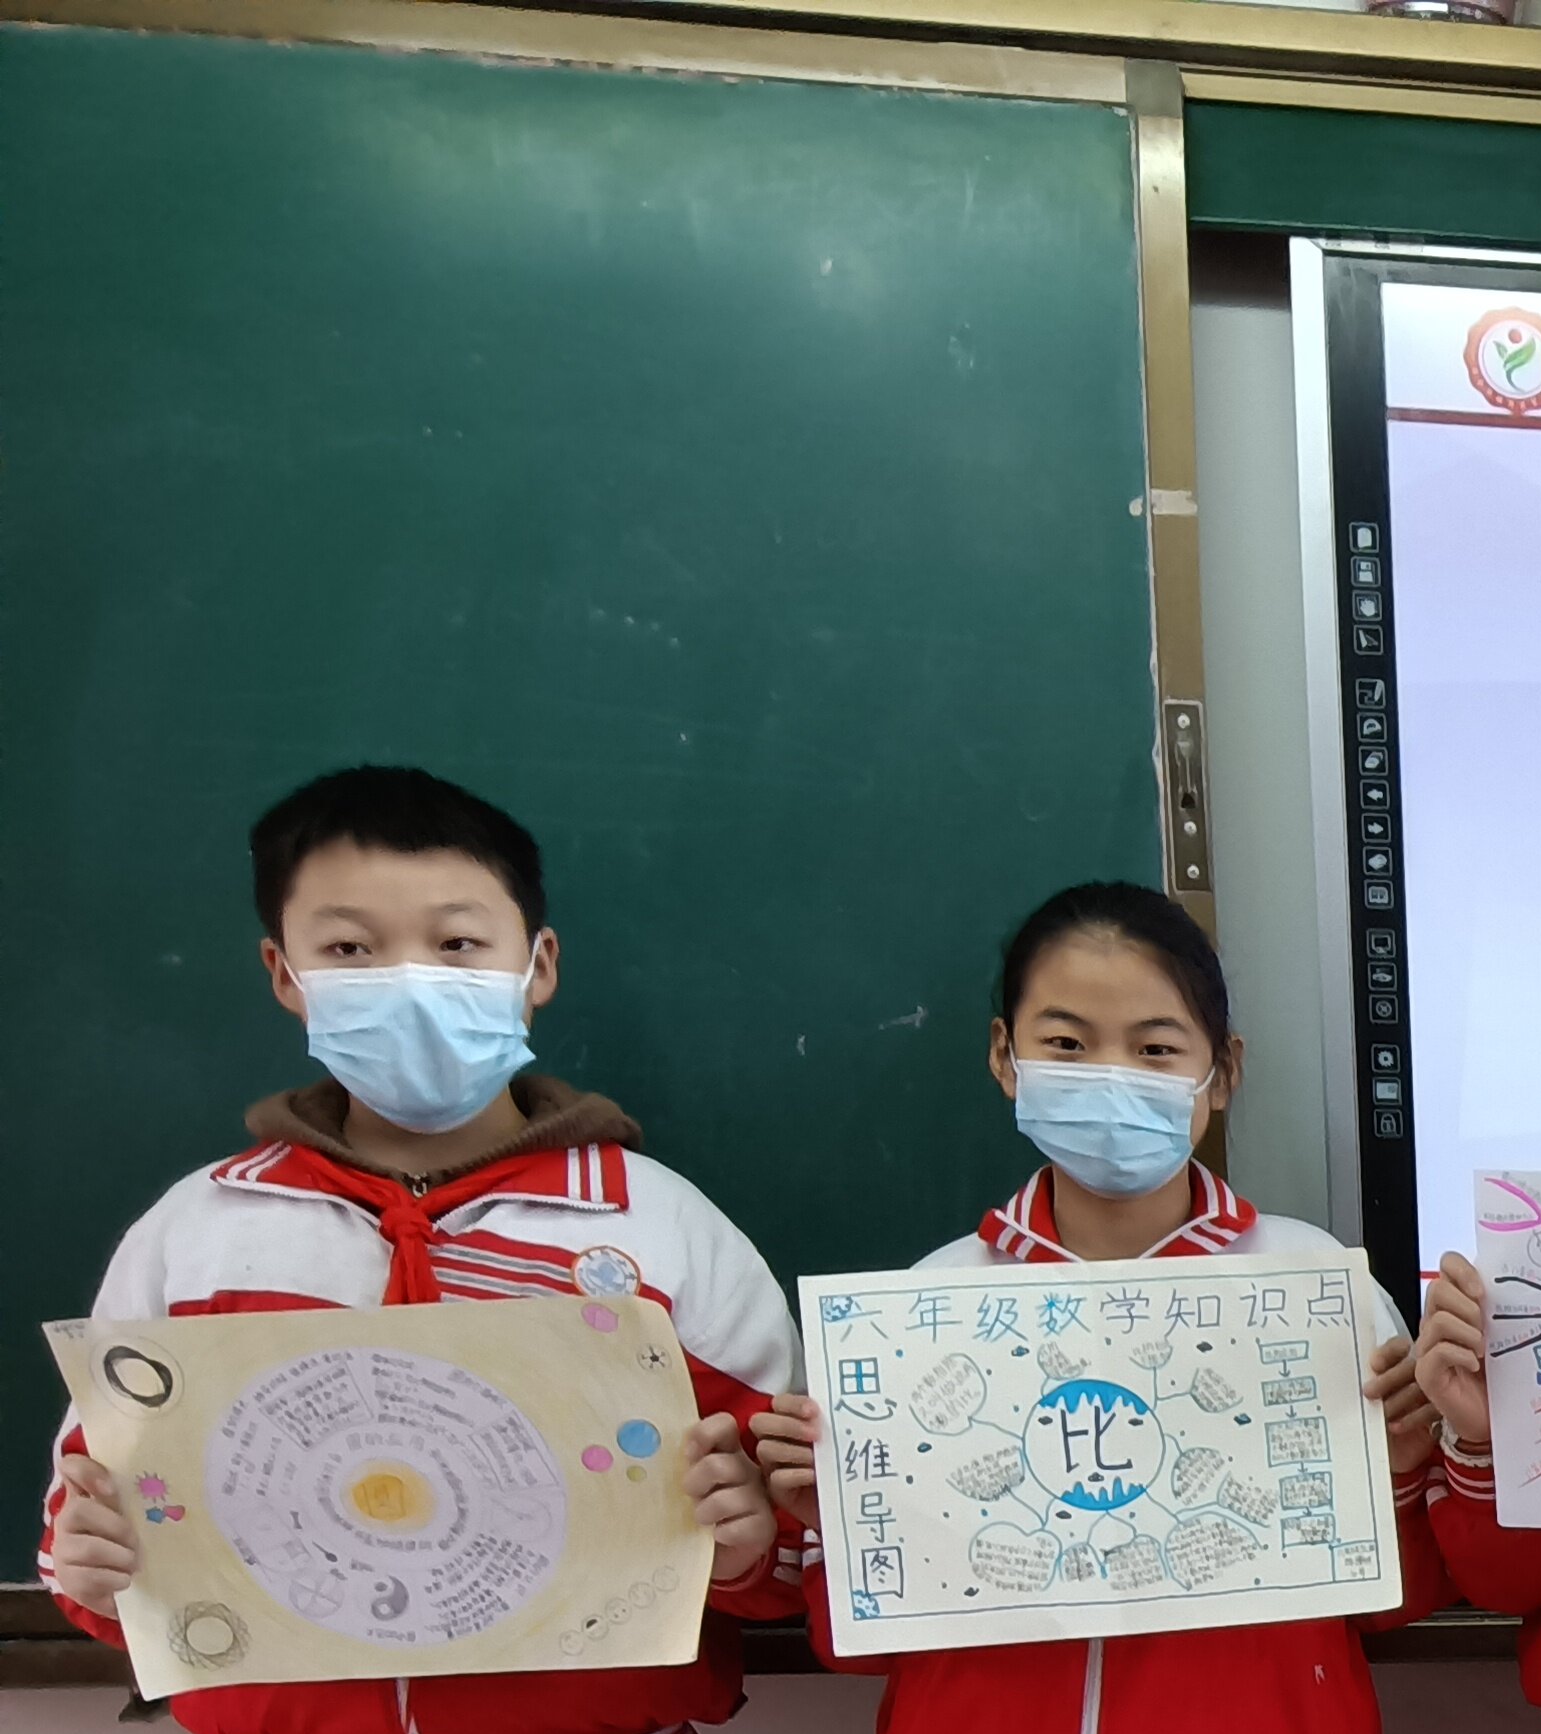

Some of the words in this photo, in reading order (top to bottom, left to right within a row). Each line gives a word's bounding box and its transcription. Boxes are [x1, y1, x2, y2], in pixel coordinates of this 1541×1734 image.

[838, 1274, 1352, 1342] 六年级数学知识点
[1060, 1406, 1133, 1474] 比
[835, 1357, 905, 1599] 思维导图
